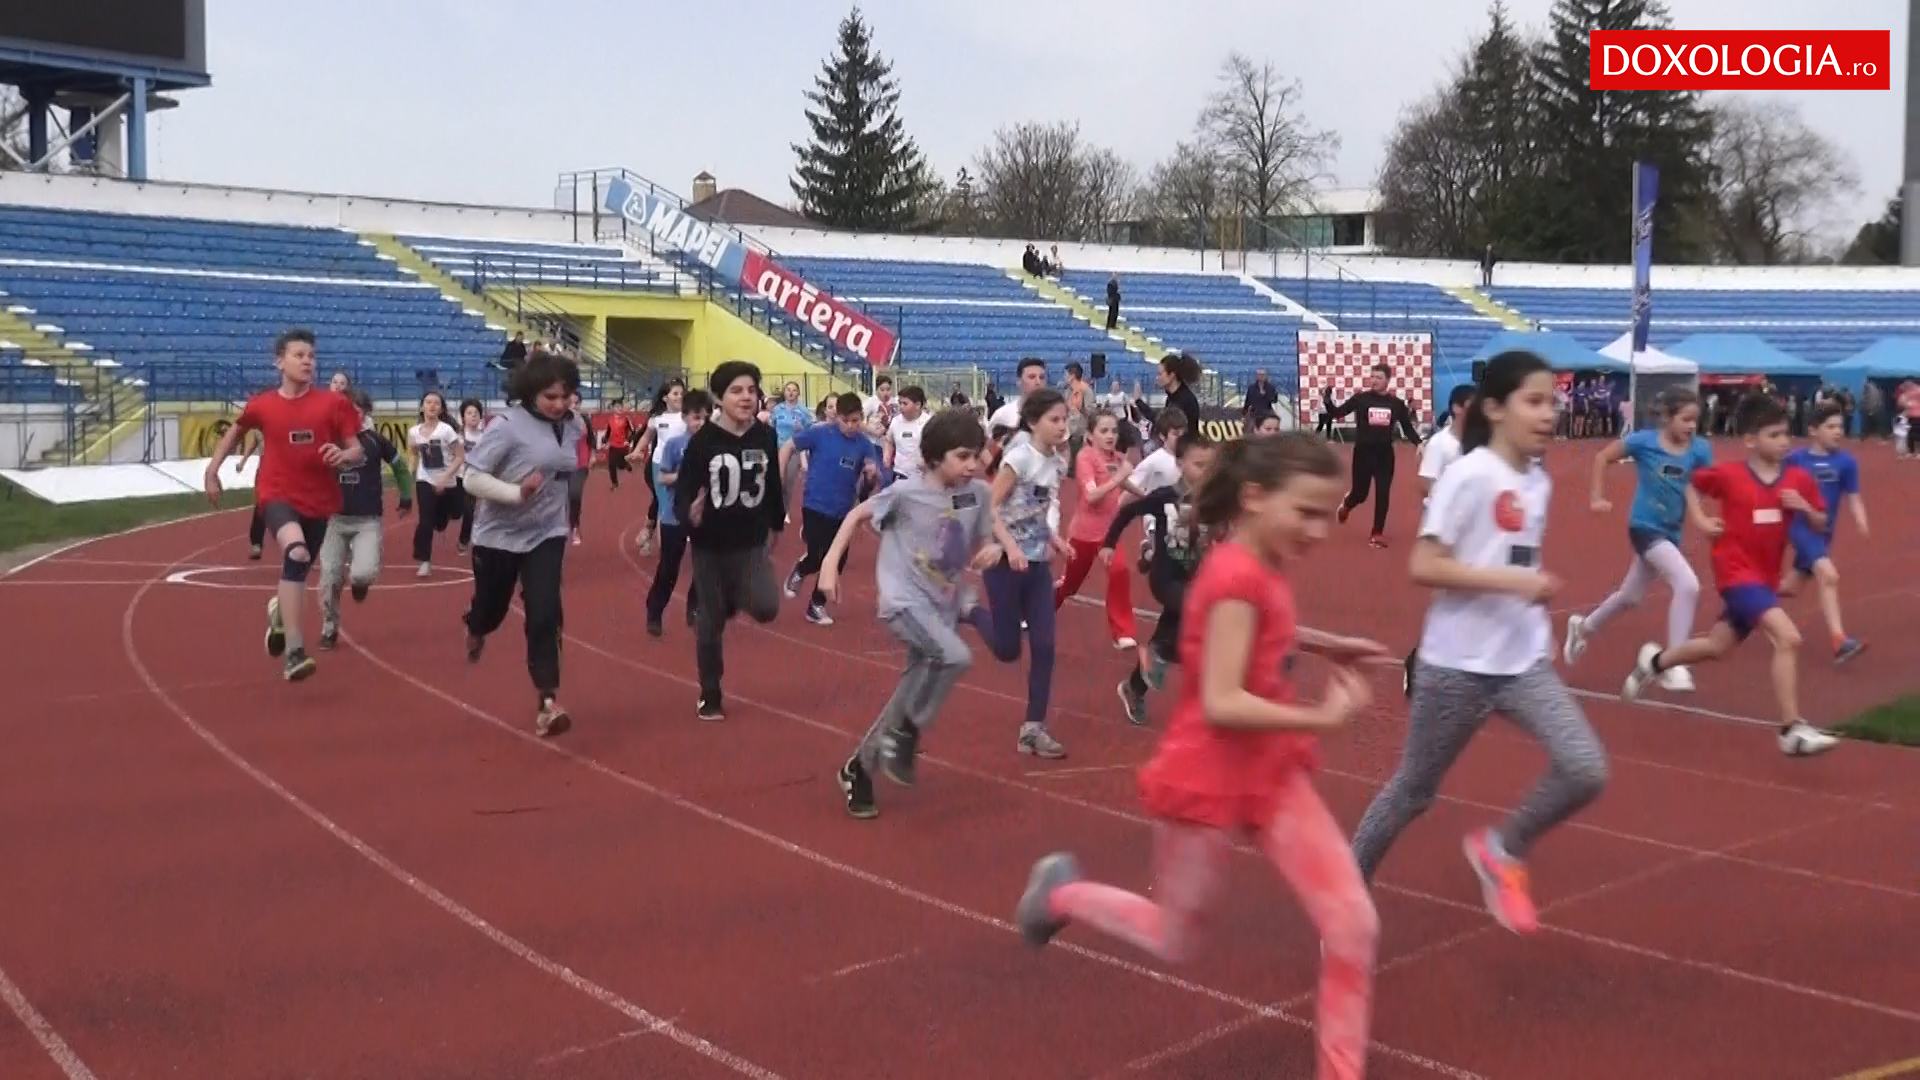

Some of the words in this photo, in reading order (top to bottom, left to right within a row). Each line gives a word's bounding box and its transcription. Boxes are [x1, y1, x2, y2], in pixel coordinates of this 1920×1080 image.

[646, 200, 730, 269] MAPEI
[757, 270, 873, 358] artera
[708, 452, 769, 510] 03
